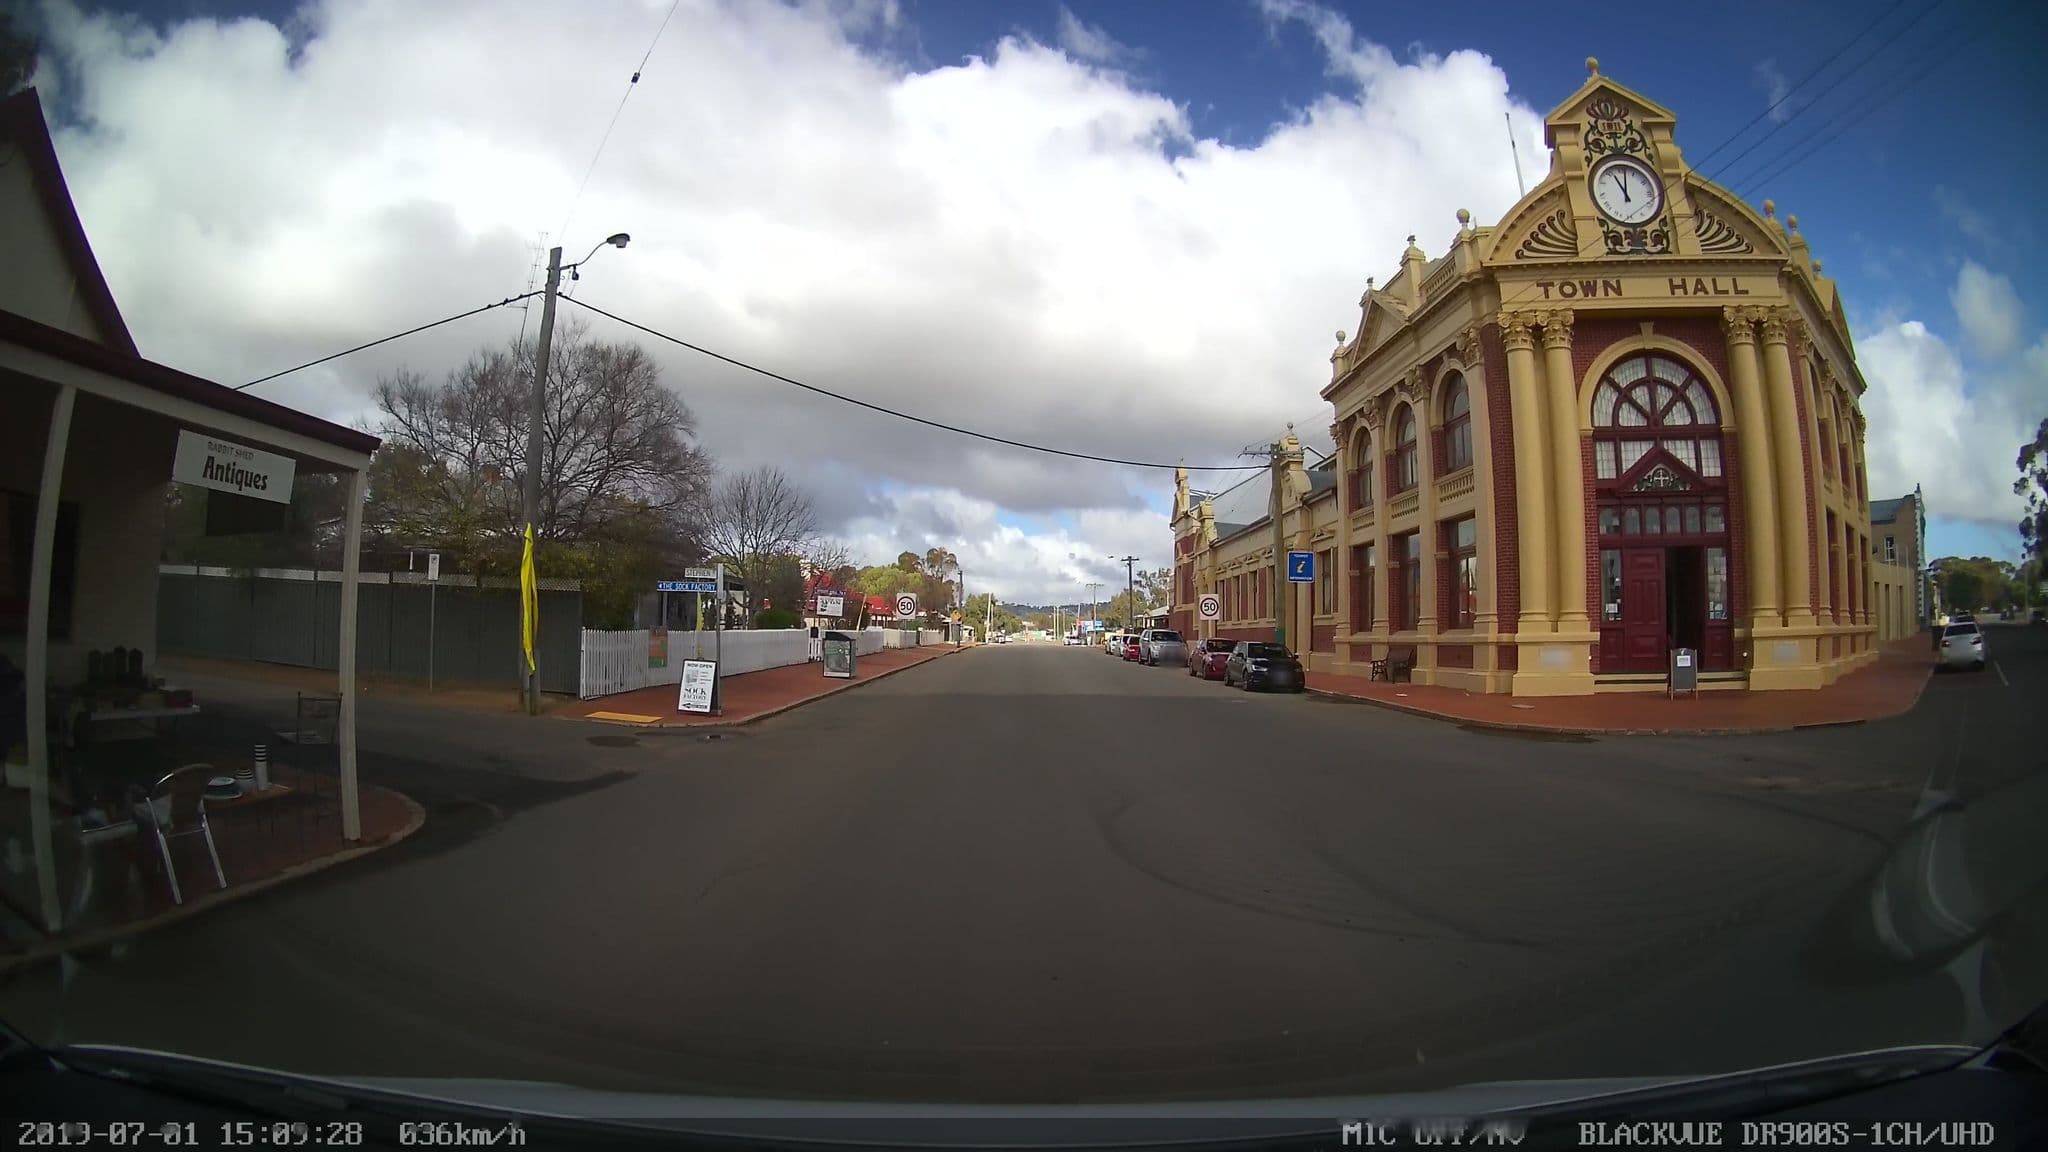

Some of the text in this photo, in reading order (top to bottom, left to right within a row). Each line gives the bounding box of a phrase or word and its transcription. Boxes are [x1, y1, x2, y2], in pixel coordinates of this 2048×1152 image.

[1536, 277, 1750, 299] TOWN HALL
[202, 456, 268, 491] Antiques
[663, 582, 715, 591] THE SOCK FACTORY
[900, 602, 912, 611] 50
[1204, 602, 1216, 611] 50
